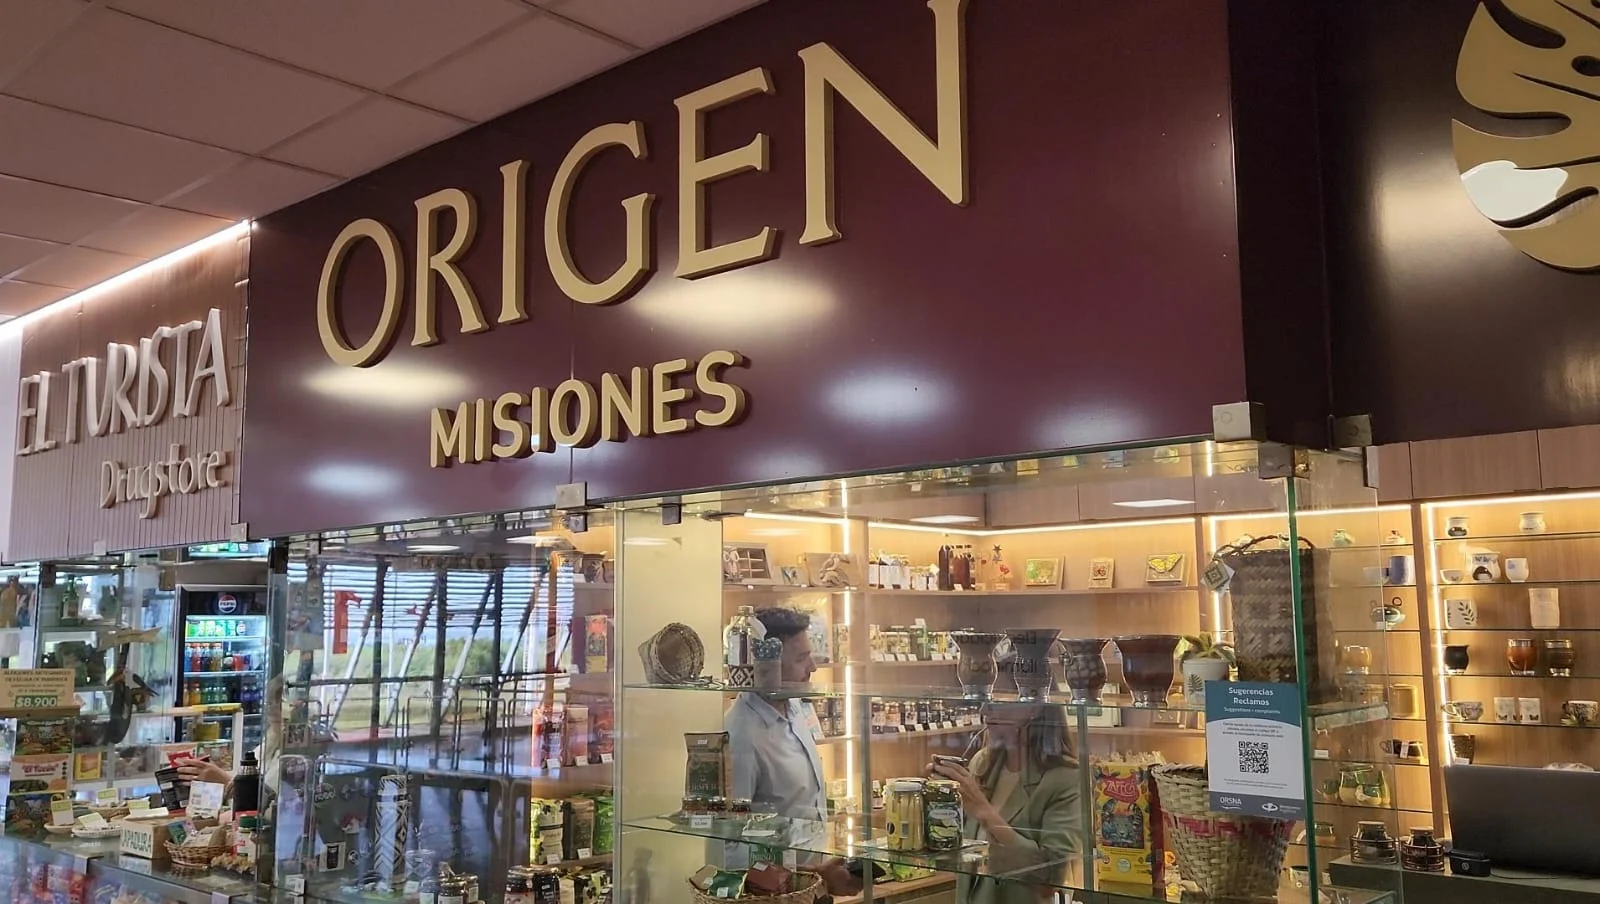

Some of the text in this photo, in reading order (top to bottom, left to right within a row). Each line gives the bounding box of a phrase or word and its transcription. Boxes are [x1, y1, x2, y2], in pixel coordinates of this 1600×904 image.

[316, 0, 970, 369] ORIGEN
[16, 308, 229, 456] EL TURISTA
[430, 350, 752, 468] MISIONES
[101, 443, 226, 519] Drugstore
[15, 696, 57, 708] $8.900
[1228, 686, 1274, 696] Sugerencias
[1233, 697, 1270, 706] Reclamos
[1220, 796, 1242, 805] ORSNA
